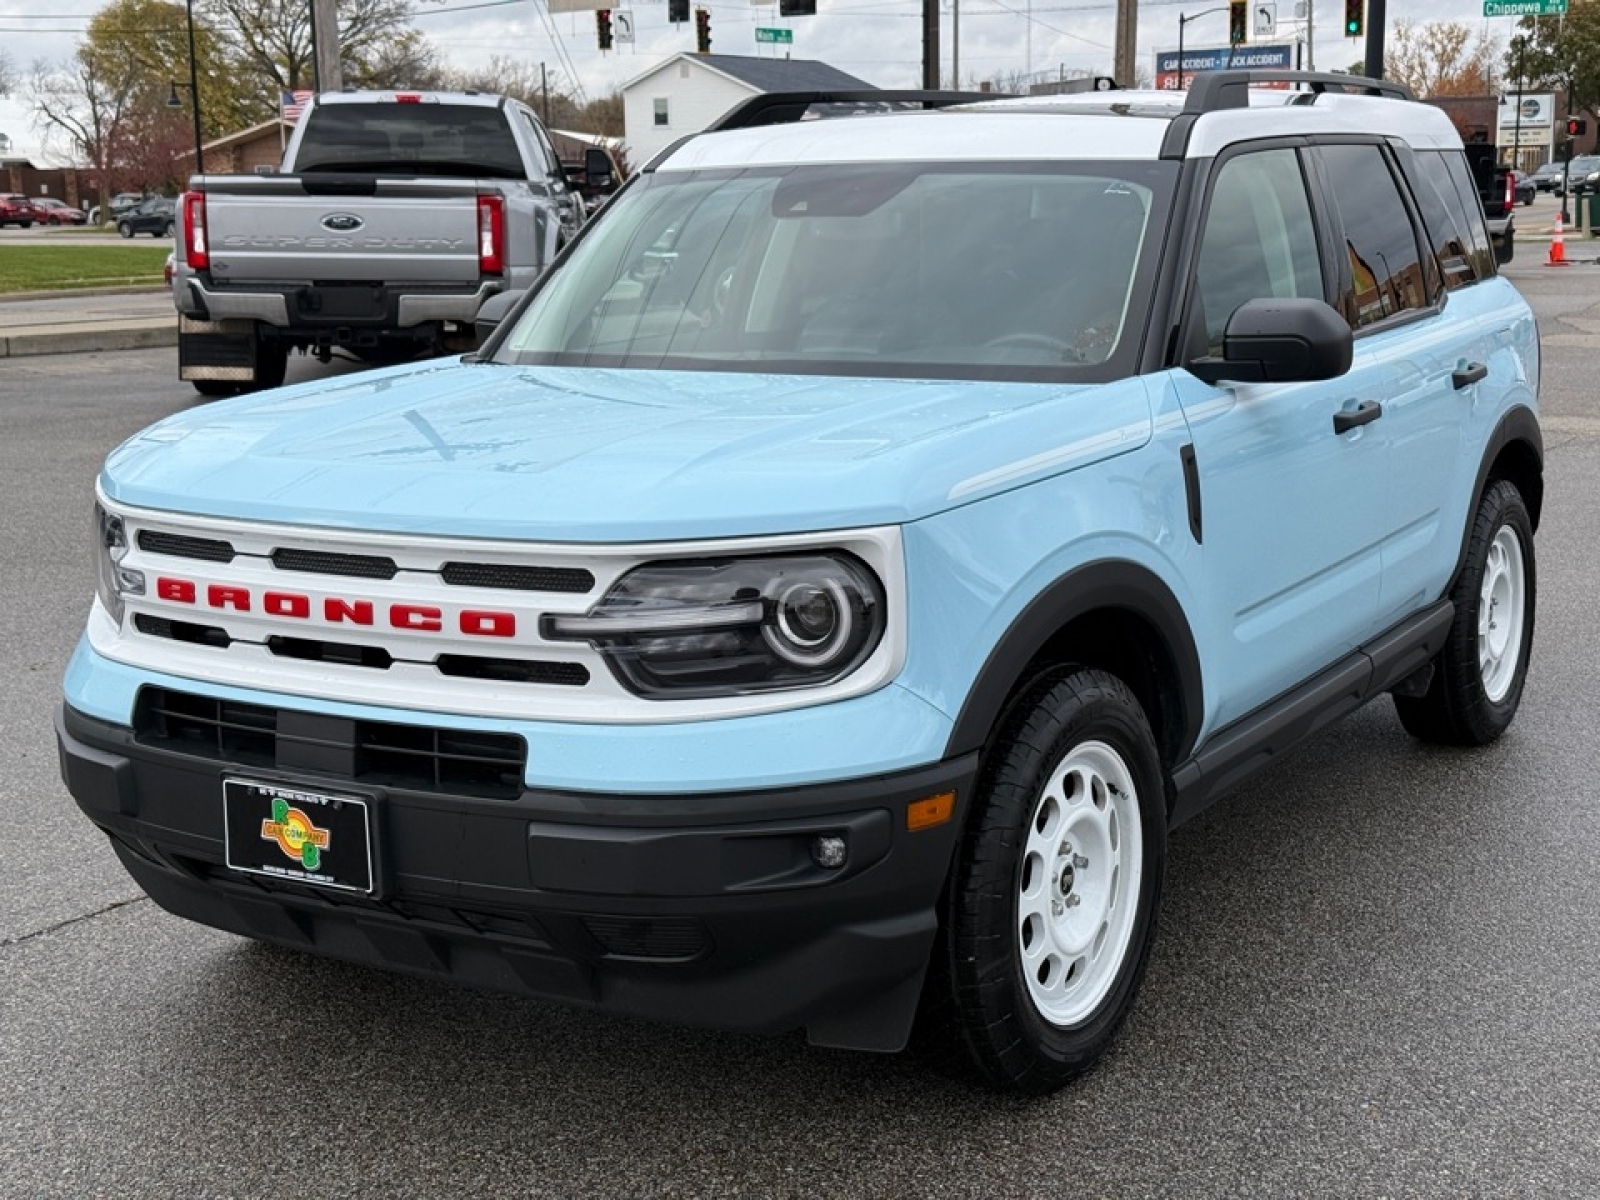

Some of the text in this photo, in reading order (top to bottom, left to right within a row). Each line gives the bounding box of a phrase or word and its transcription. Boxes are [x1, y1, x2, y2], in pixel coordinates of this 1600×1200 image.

[1486, 3, 1541, 15] Chippewa
[1246, 53, 1284, 65] ACCIDENT
[224, 235, 464, 249] SUPER DUTY
[157, 576, 516, 638] BRONCO
[284, 827, 324, 842] COMPANY
